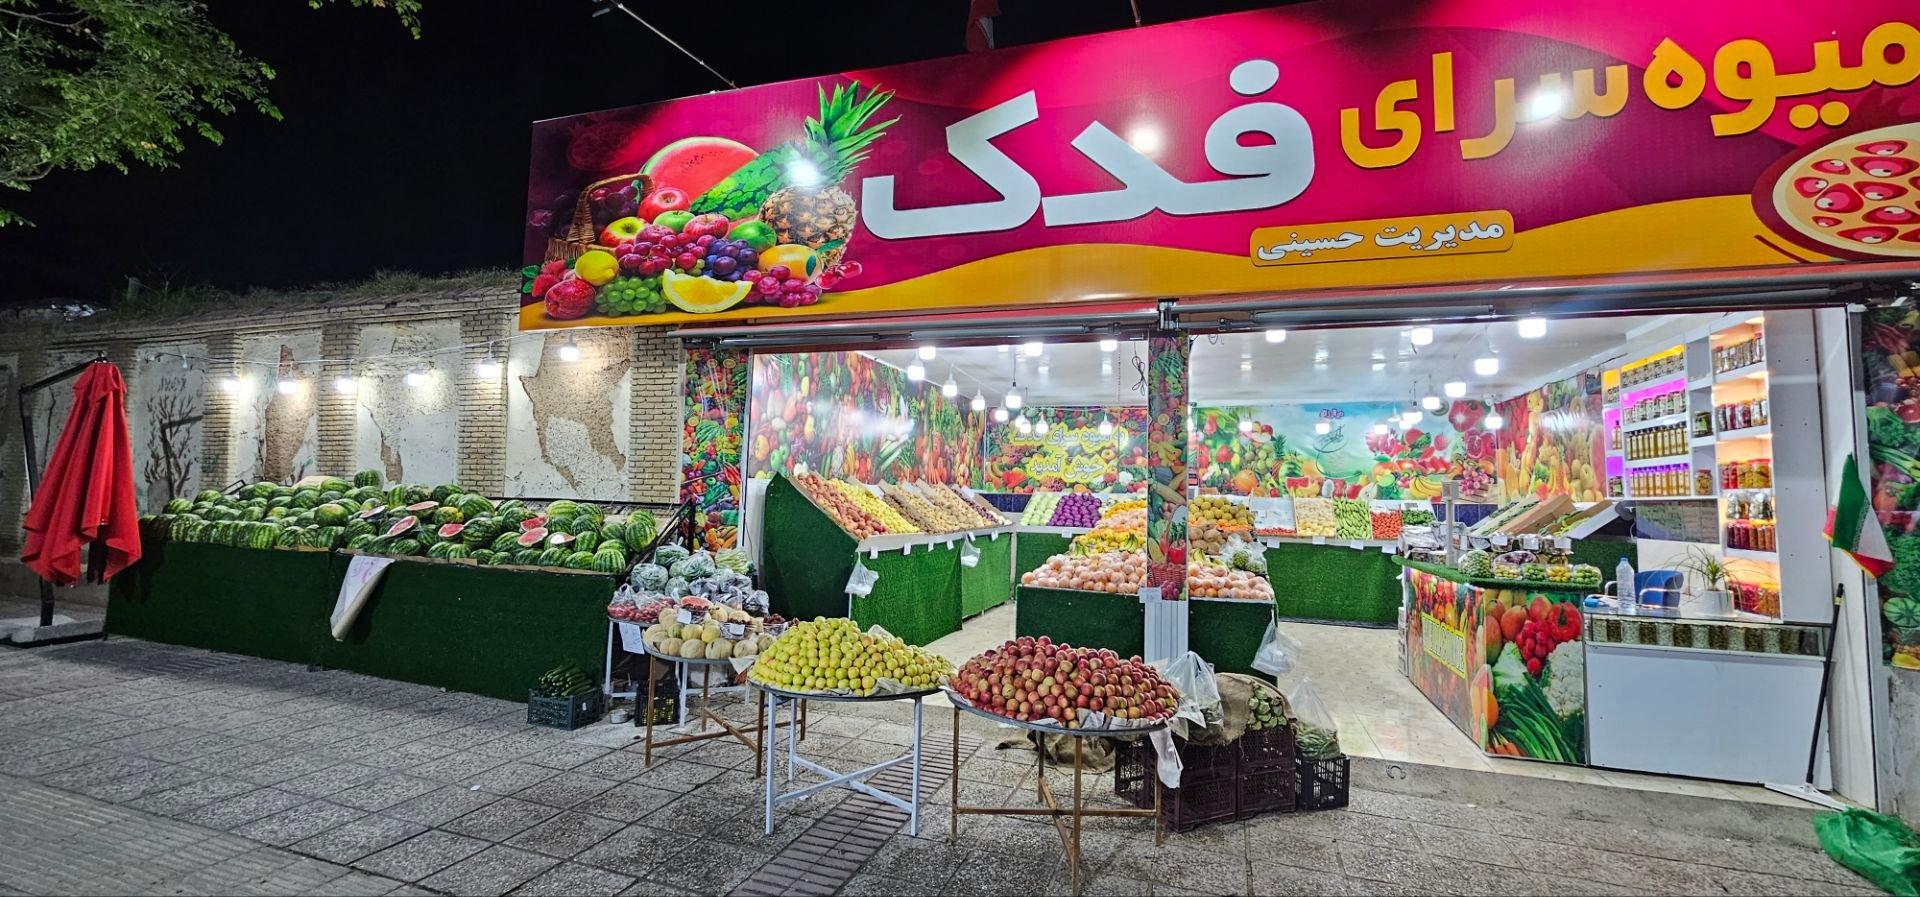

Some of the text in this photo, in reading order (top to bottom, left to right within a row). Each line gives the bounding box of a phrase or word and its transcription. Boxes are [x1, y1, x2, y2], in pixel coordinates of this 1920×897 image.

[862, 21, 1920, 239] میوه سرای فدک
[1257, 220, 1505, 261] مدیریت حسینی
[1031, 455, 1103, 479] خوش آمدید
